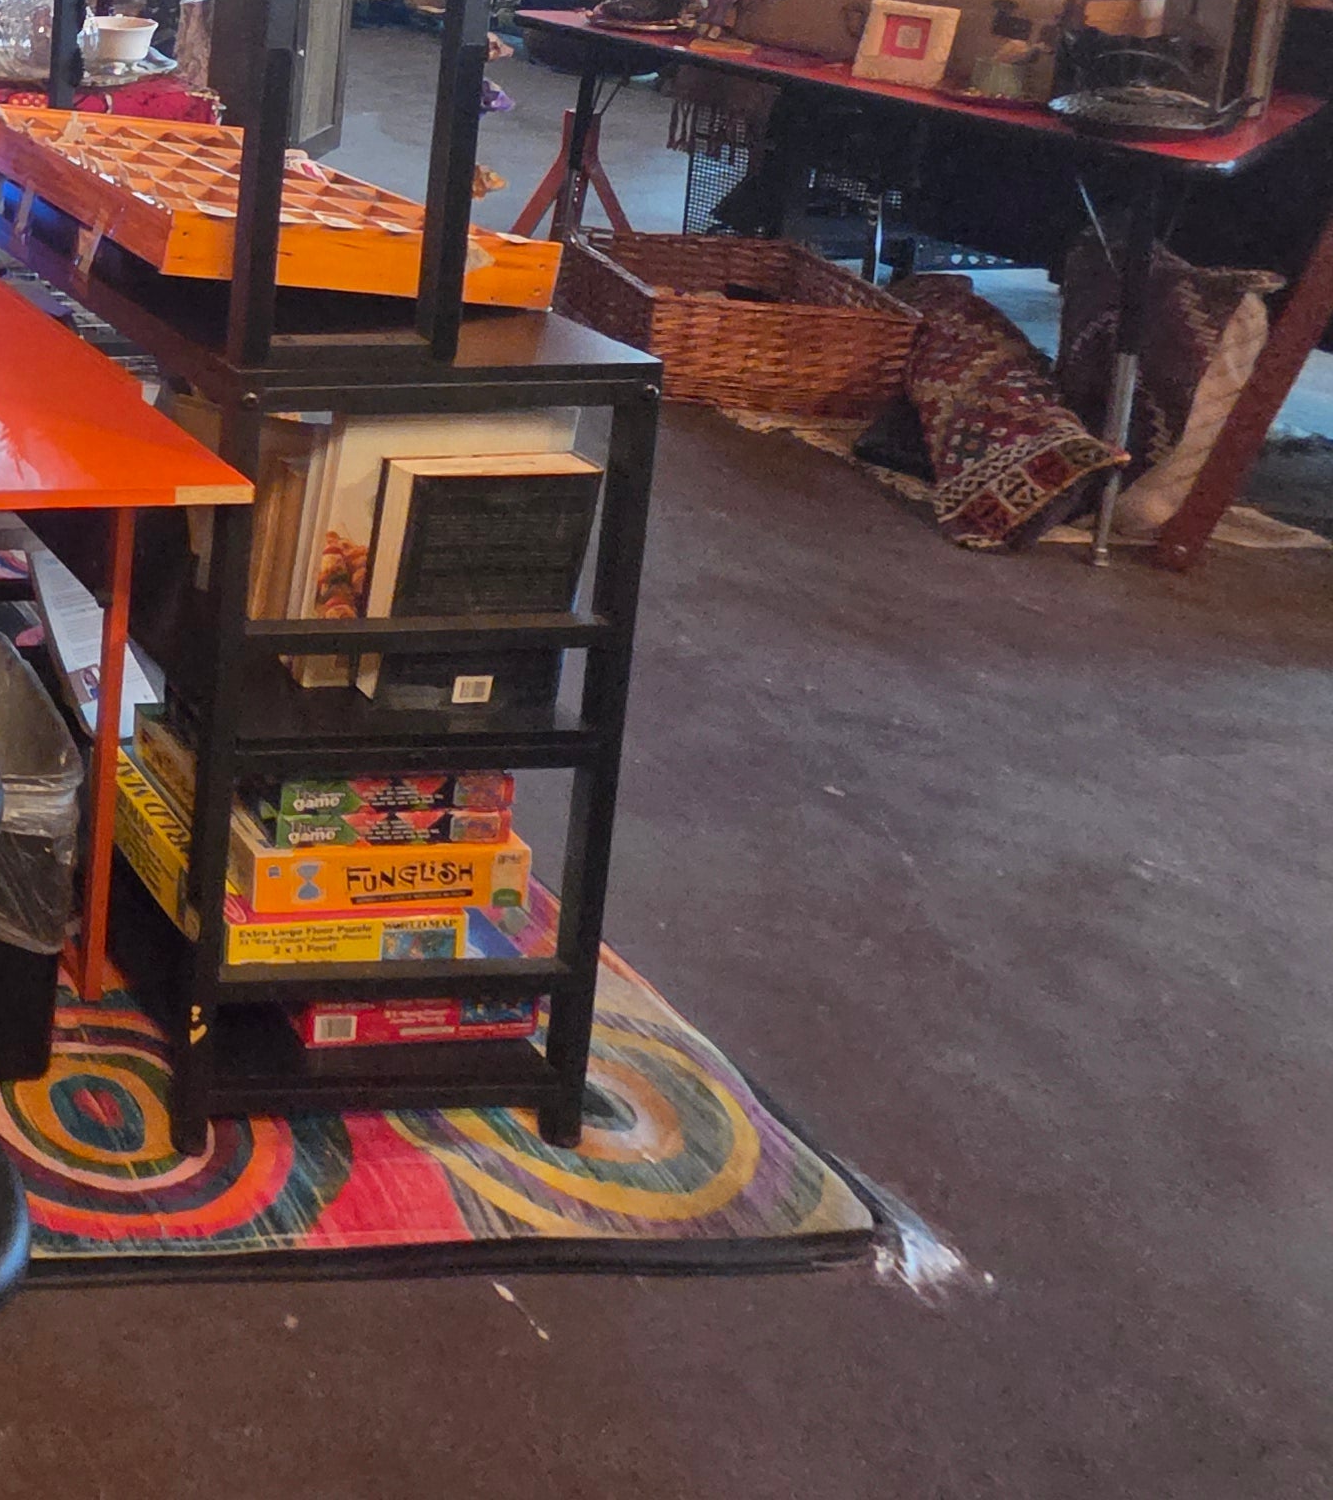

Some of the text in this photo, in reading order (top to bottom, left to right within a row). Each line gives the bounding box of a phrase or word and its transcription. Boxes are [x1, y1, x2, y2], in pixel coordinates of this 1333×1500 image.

[292, 795, 341, 812] game
[288, 829, 336, 845] game
[238, 929, 269, 938] Extra
[271, 928, 303, 938] Large
[337, 923, 373, 933] Puzzle
